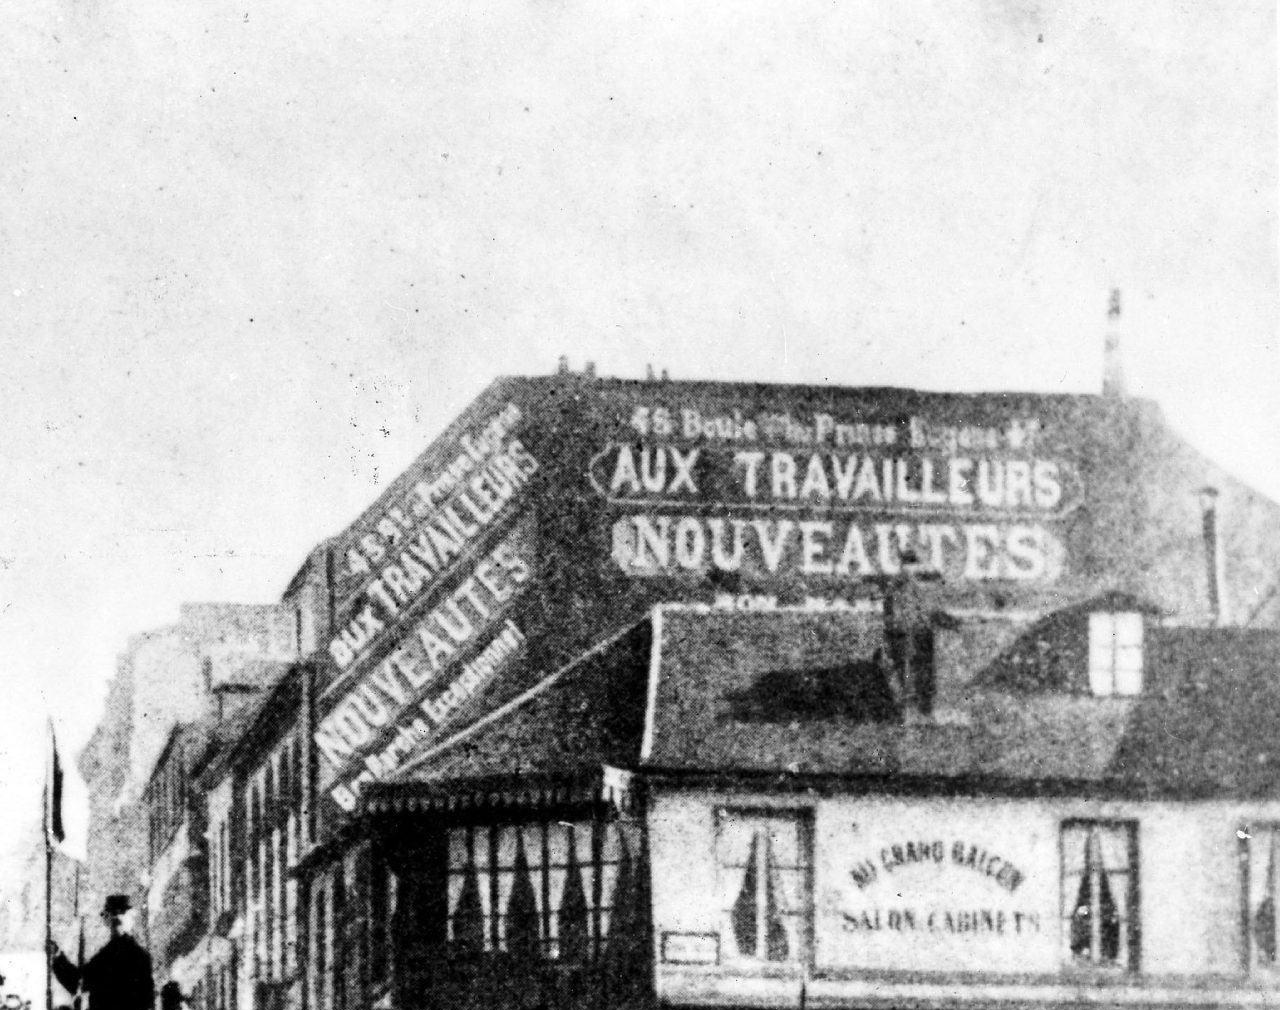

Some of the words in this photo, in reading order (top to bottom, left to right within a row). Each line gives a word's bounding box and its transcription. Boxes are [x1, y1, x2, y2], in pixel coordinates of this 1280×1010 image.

[367, 439, 540, 614] TRAVAILLEURS
[609, 444, 701, 495] AUX
[734, 451, 1061, 508] TRAVAILLEURS
[314, 543, 529, 768] NOUVEAUTES
